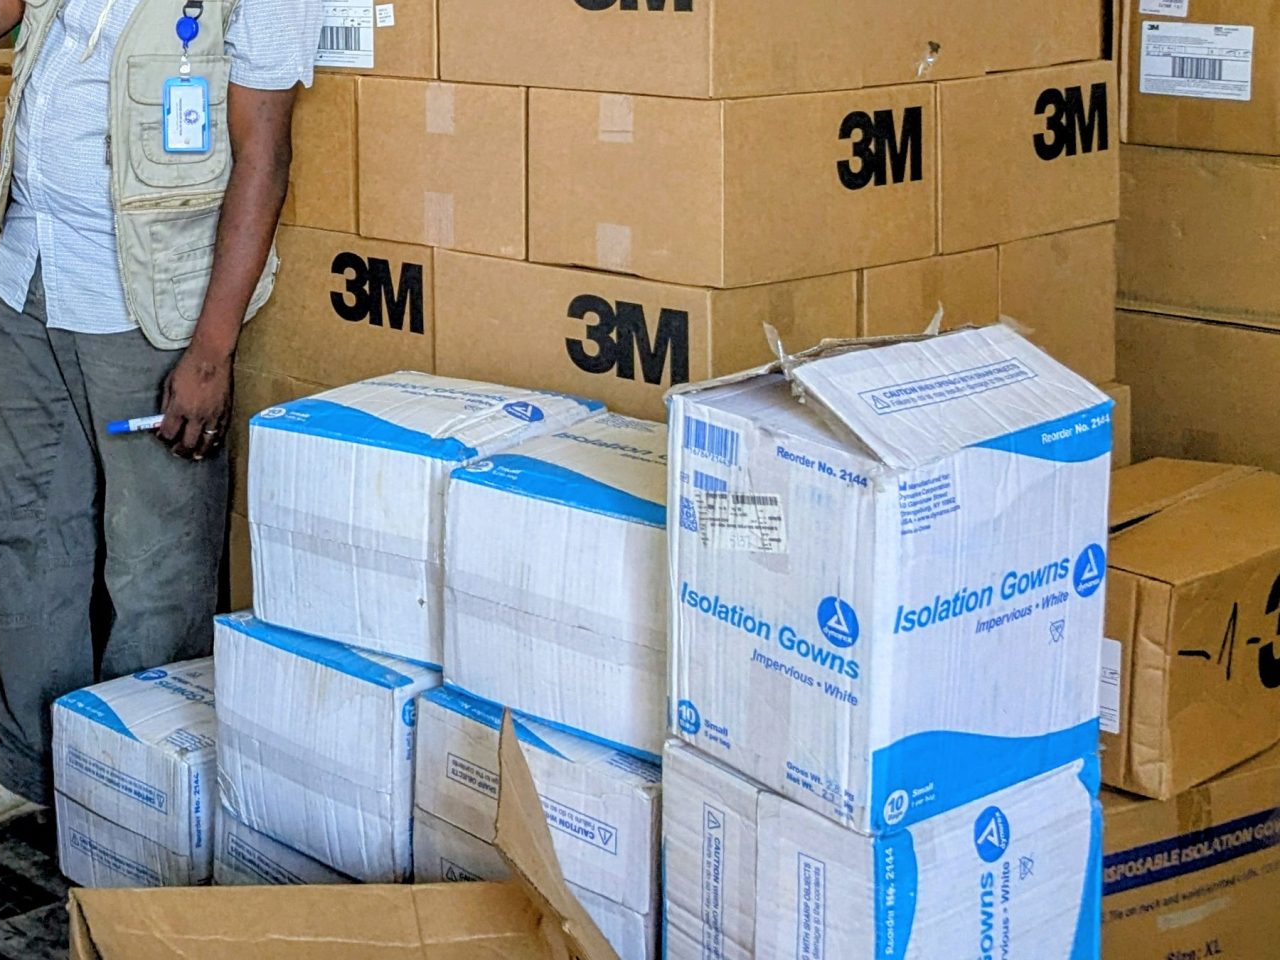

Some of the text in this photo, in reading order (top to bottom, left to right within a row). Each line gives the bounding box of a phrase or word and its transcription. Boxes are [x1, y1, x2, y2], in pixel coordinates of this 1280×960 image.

[1032, 82, 1109, 161] 3M
[836, 105, 923, 191] 3M
[329, 251, 425, 335] 3M
[565, 294, 690, 388] 3M
[883, 386, 919, 399] CAUTION
[1041, 427, 1073, 445] Reorder
[1074, 422, 1090, 435] No.
[776, 445, 868, 489] Reorder No. 2144
[893, 557, 1071, 635] Isolation Gowns
[975, 590, 1070, 635] Impervious White
[680, 581, 860, 680] Isolation Gowns
[752, 648, 858, 707] Impervious White
[679, 704, 697, 724] 10
[703, 718, 729, 737] Small
[887, 794, 904, 813] 10
[911, 782, 934, 798] Small
[557, 818, 596, 840] CAUTION
[713, 836, 721, 884] CAUTION
[885, 847, 894, 880] 2144
[1103, 849, 1181, 884] ISPOSABLE
[1181, 826, 1253, 863] ISOLATION
[802, 862, 812, 932] SHARP OBJECTS
[1000, 862, 1010, 904] White
[980, 871, 994, 960] owns
